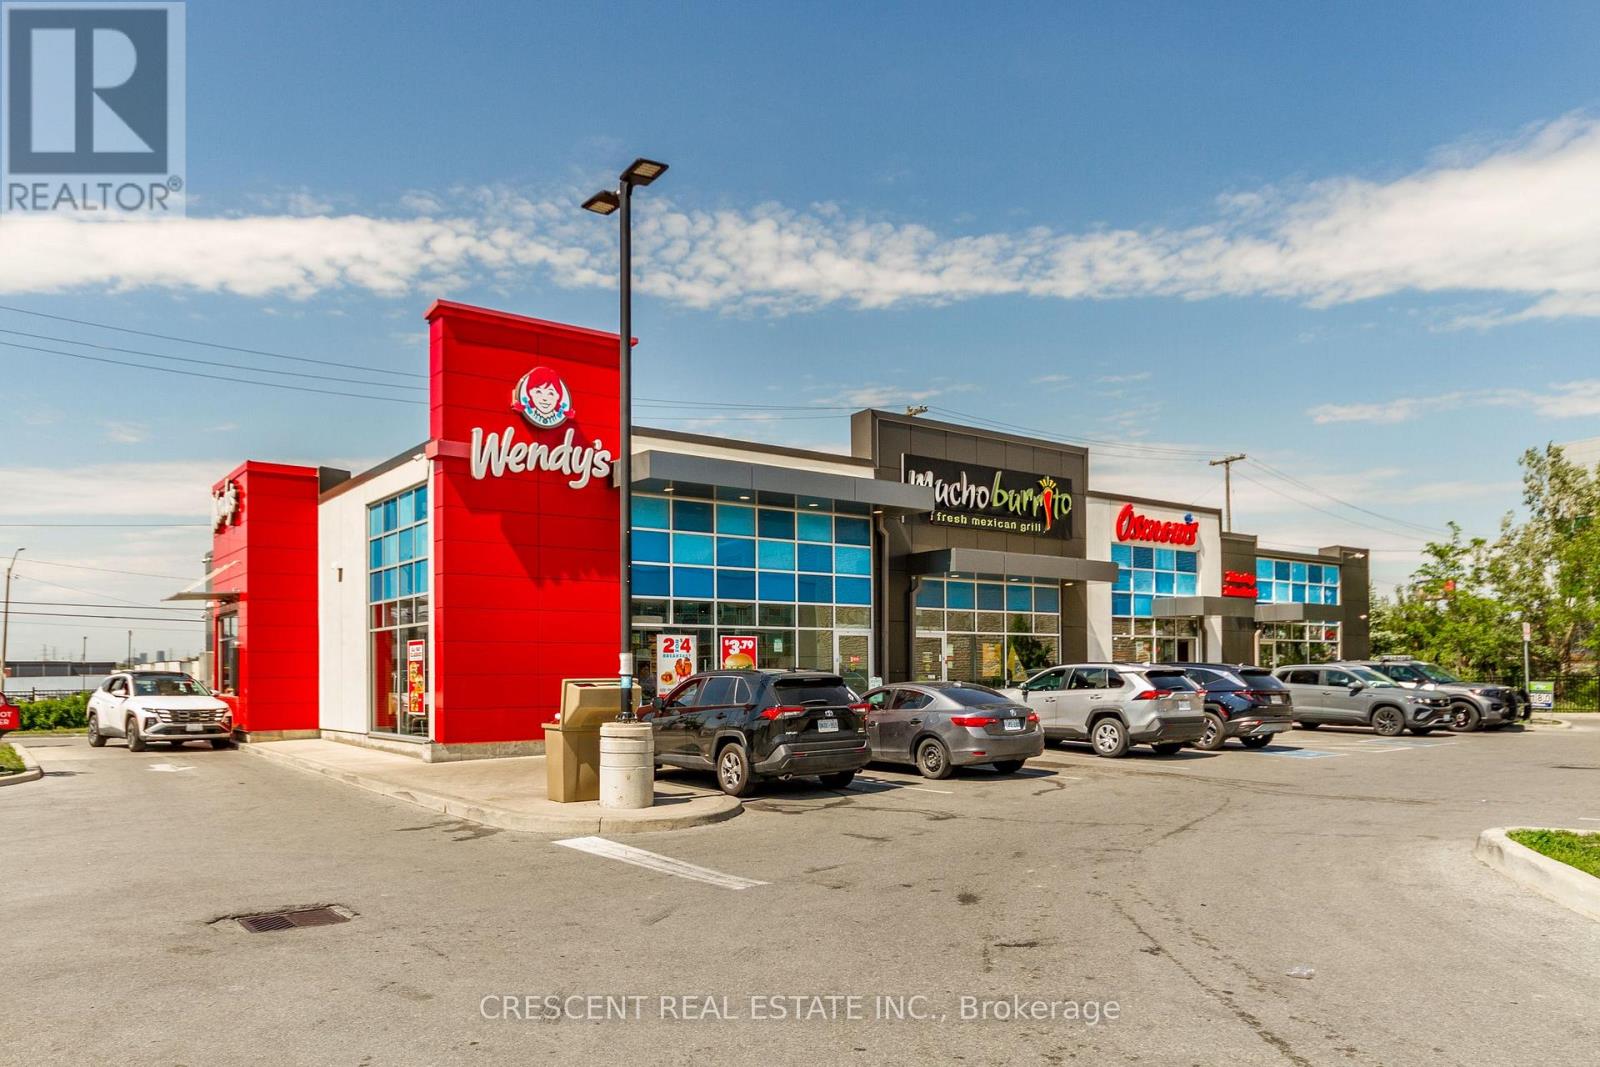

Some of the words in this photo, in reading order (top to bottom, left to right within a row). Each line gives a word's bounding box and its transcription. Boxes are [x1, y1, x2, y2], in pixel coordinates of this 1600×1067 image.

[470, 426, 611, 489] Wendy's
[936, 511, 968, 525] fresh
[971, 516, 1017, 530] mexican
[1020, 522, 1041, 533] grill
[662, 637, 675, 653] 2
[724, 639, 754, 655] $3.79
